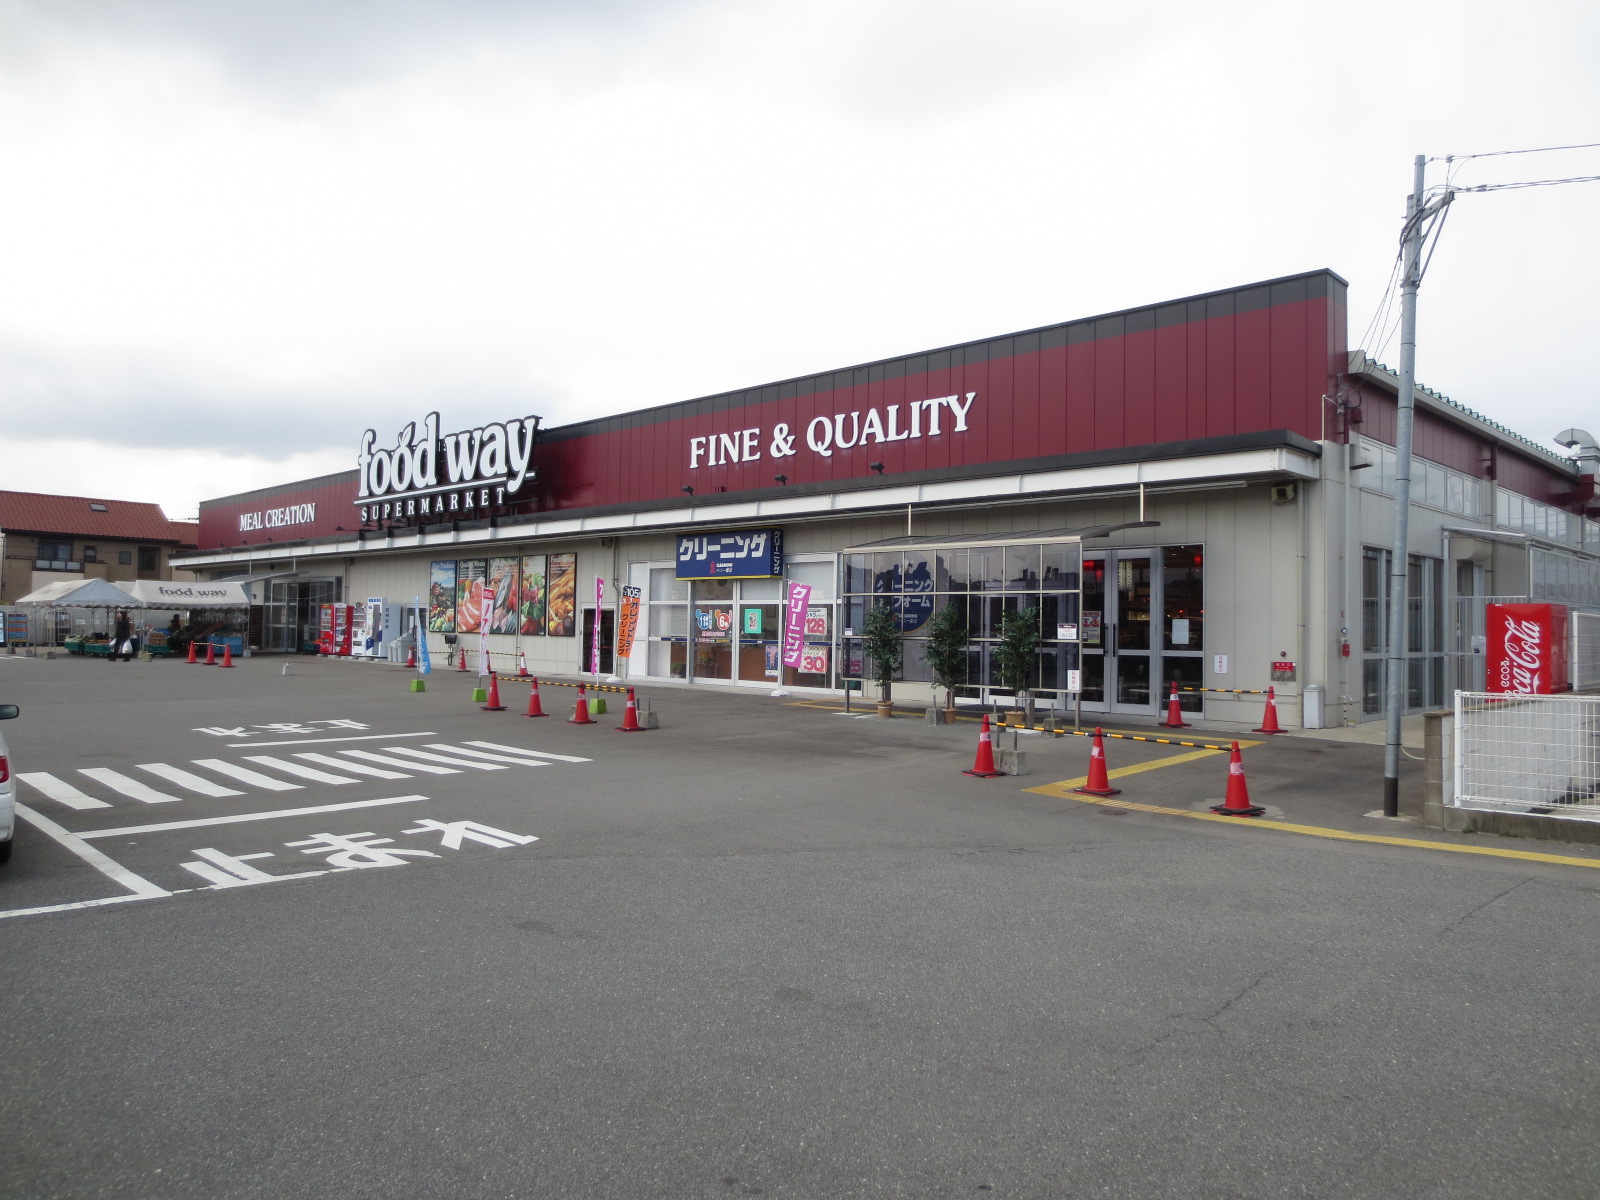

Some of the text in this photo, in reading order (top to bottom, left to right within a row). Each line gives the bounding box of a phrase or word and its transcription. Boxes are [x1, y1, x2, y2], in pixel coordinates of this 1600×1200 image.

[358, 411, 541, 498] food way
[690, 391, 976, 468] FINE & QUALITY
[239, 502, 316, 532] MEAL CREATION
[361, 487, 505, 522] SUPERMARKET
[679, 532, 767, 561] クリーニング
[159, 585, 228, 597] food way
[784, 585, 808, 663] クリーニング
[805, 617, 825, 635] 128
[1504, 614, 1540, 697] oca-Cola
[179, 818, 540, 890] 止まれ
